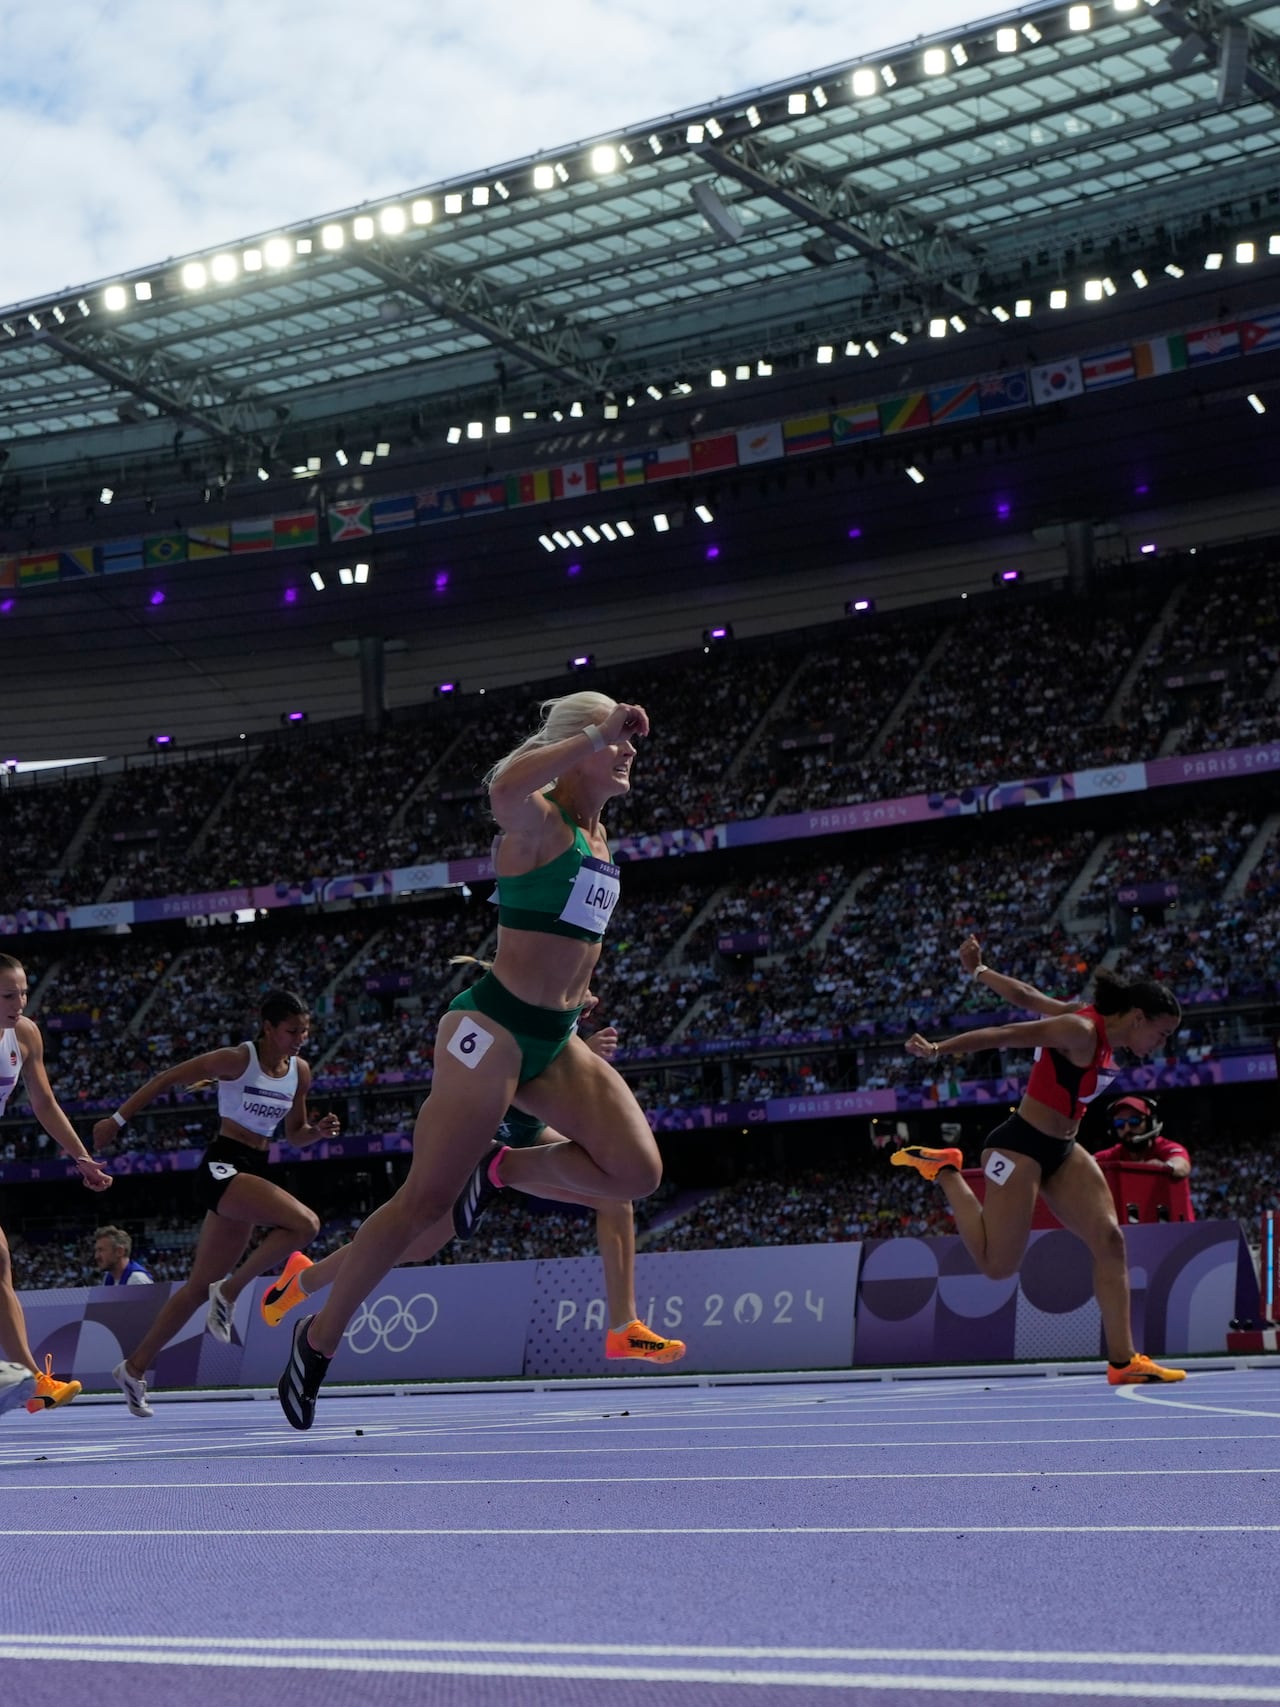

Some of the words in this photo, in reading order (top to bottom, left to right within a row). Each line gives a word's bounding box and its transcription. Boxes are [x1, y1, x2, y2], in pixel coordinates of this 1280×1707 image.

[1183, 757, 1237, 776] PARIS
[1244, 749, 1280, 768] 202
[809, 811, 857, 829] PARIS
[862, 806, 907, 822] 2024
[460, 1032, 477, 1054] 6
[788, 1100, 830, 1114] PARIS
[992, 1161, 1005, 1177] 2
[556, 1296, 684, 1331] PAIS
[703, 1290, 824, 1327] 2024
